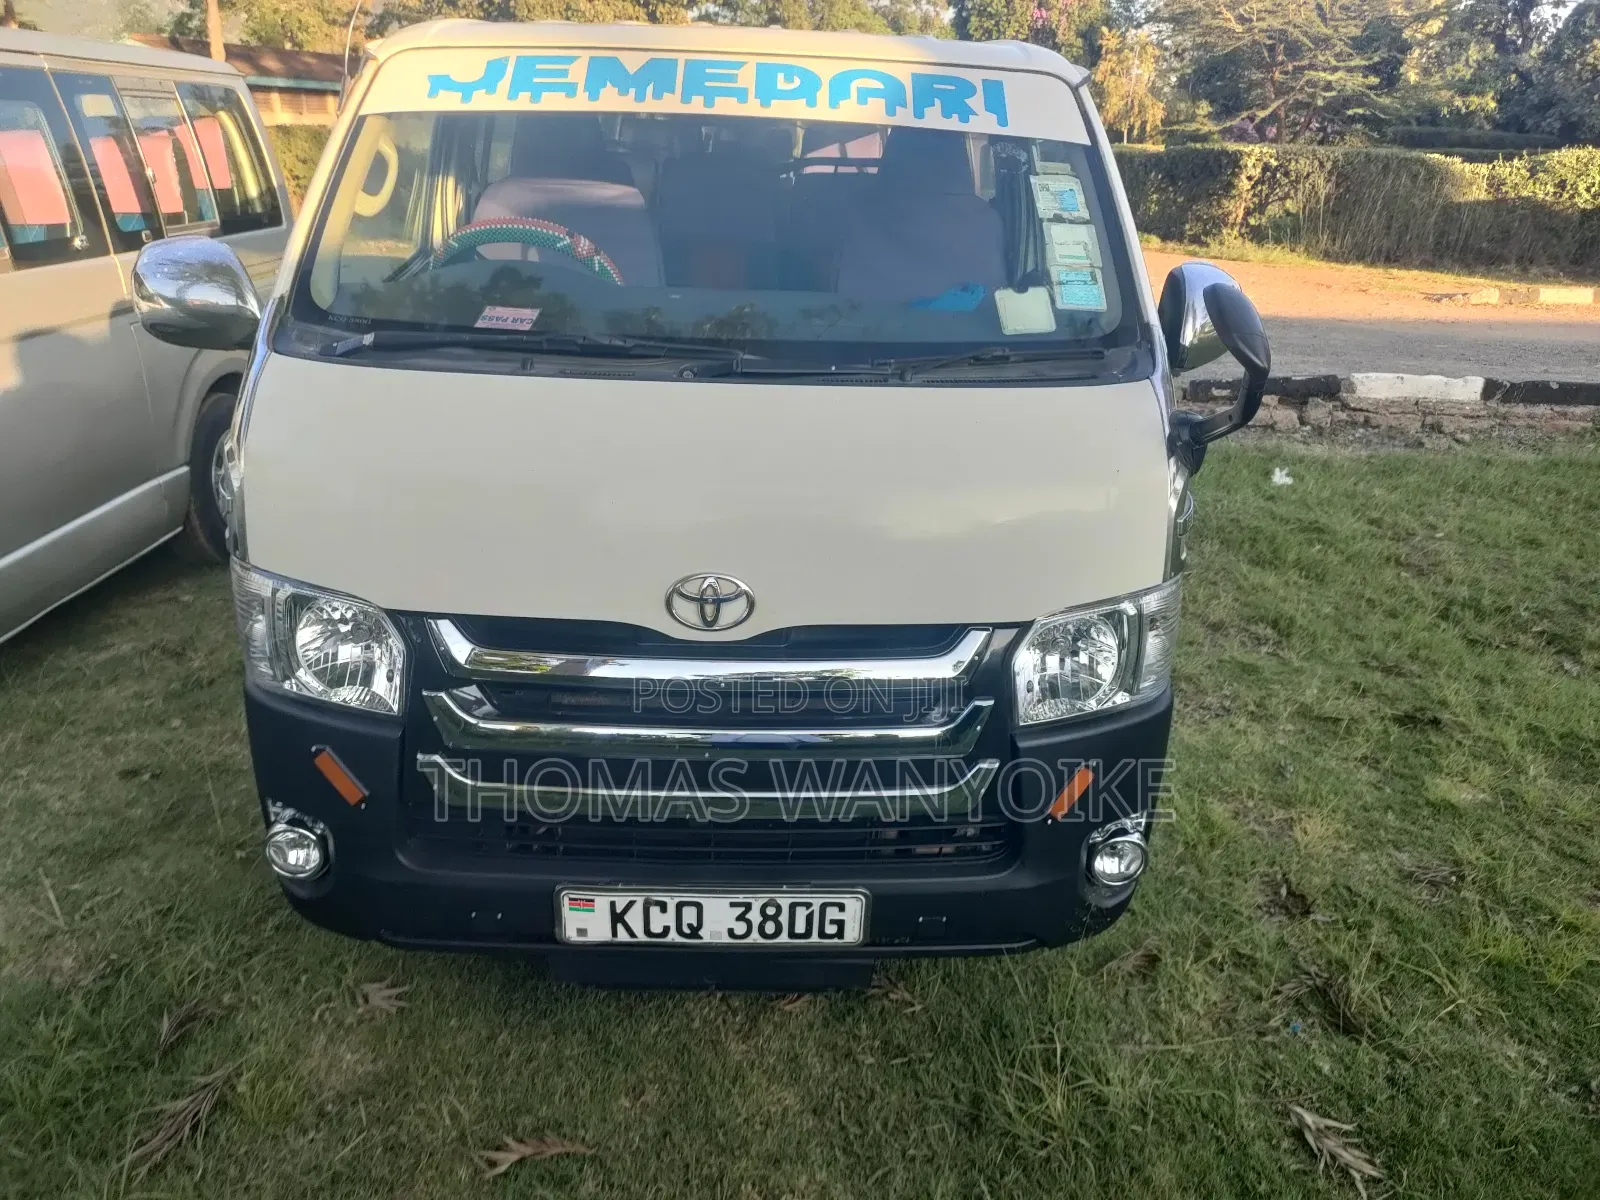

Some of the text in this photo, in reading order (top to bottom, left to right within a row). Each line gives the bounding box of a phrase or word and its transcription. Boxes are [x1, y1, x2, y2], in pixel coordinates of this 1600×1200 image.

[427, 55, 1008, 127] JEMEDARI
[480, 314, 534, 325] CAR PASS
[608, 899, 704, 940] KCQ
[727, 899, 846, 940] 380G
